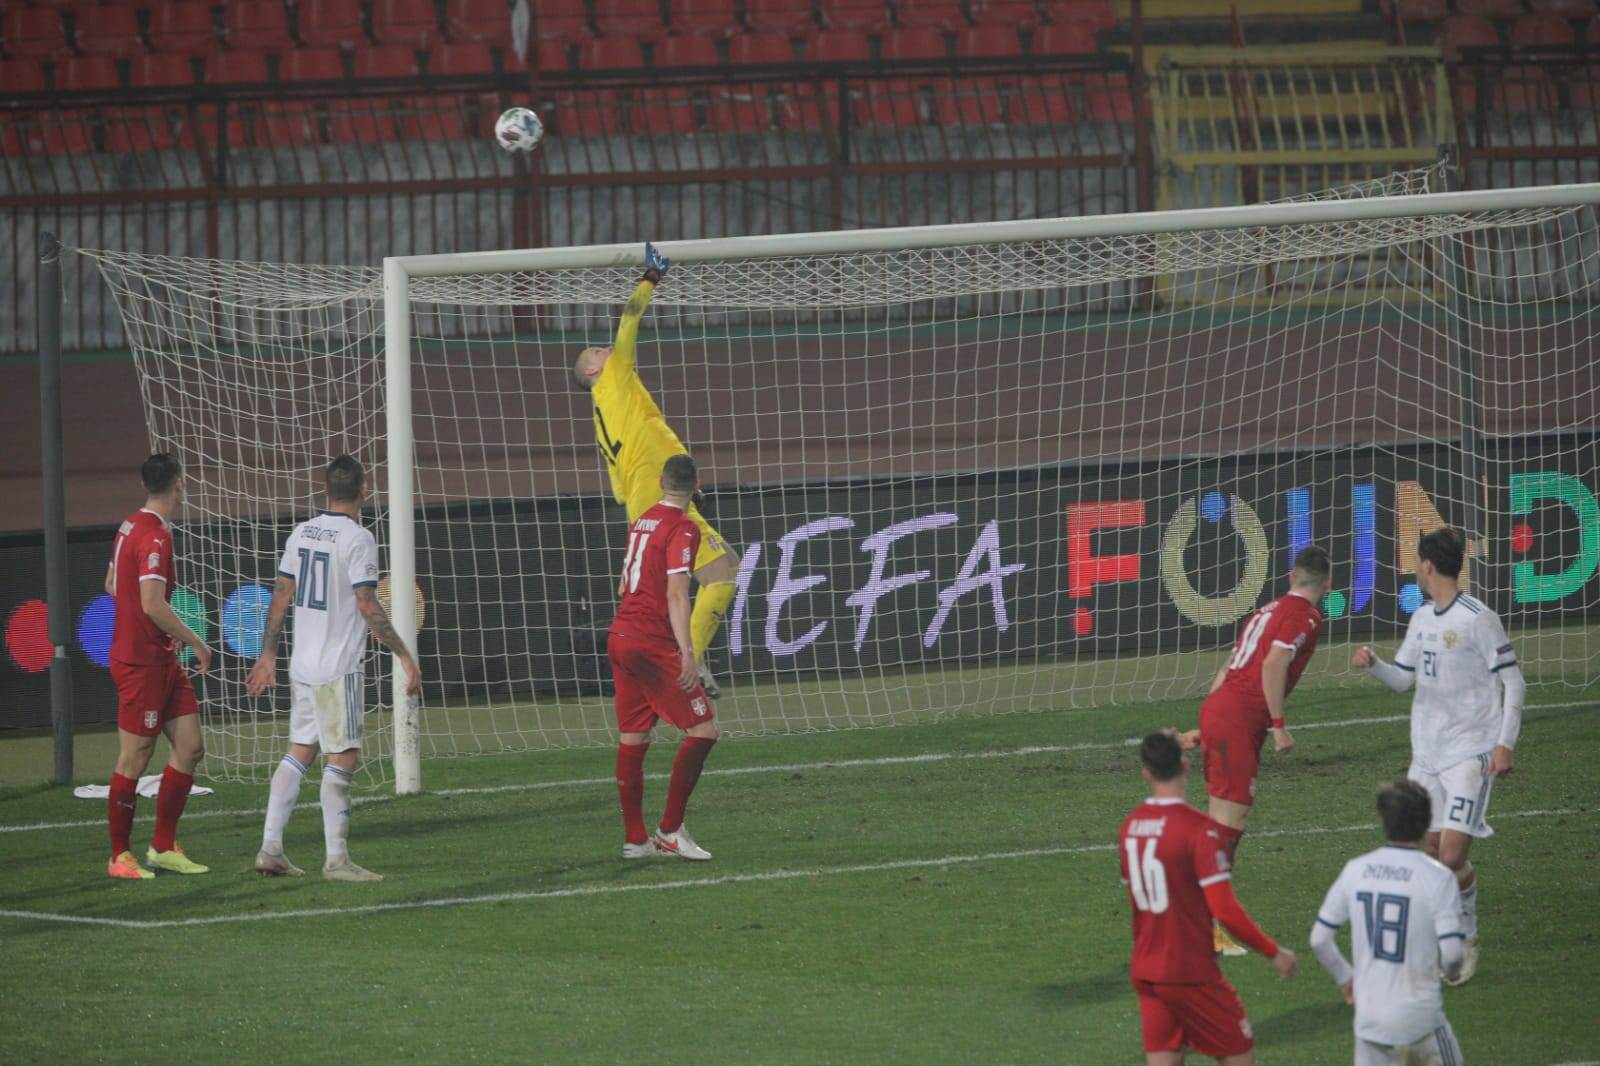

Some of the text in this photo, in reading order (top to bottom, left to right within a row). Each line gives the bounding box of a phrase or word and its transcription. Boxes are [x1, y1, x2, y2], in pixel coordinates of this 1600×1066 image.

[295, 547, 330, 612] 10
[1423, 650, 1437, 678] 21
[1449, 796, 1474, 825] 21
[1124, 837, 1169, 914] 16
[1356, 891, 1410, 963] 18
